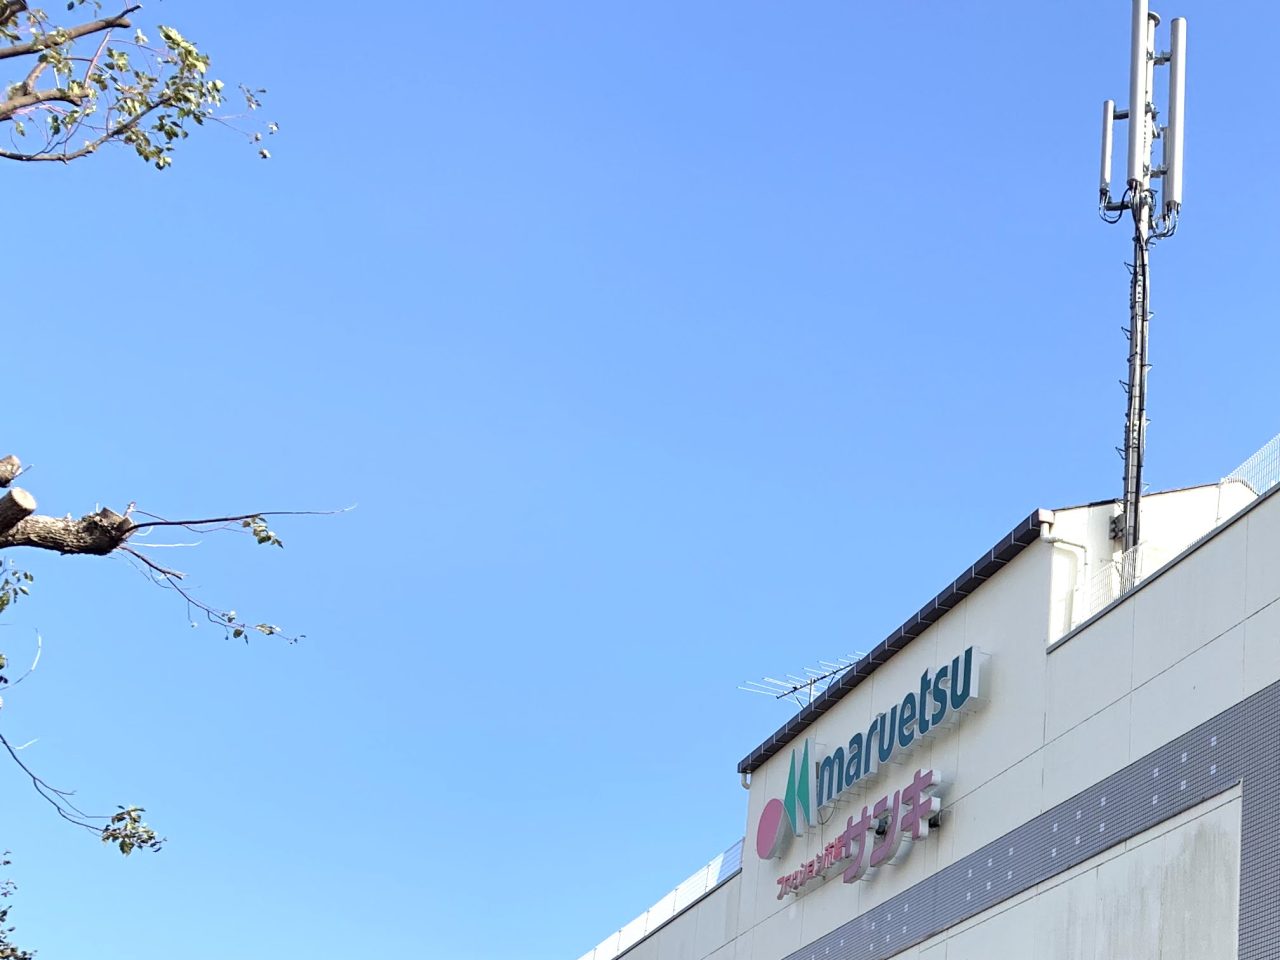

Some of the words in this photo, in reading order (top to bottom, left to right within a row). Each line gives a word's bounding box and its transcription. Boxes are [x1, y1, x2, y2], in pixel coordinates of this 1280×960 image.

[817, 646, 973, 808] maruetsu
[843, 768, 934, 883] サンキ
